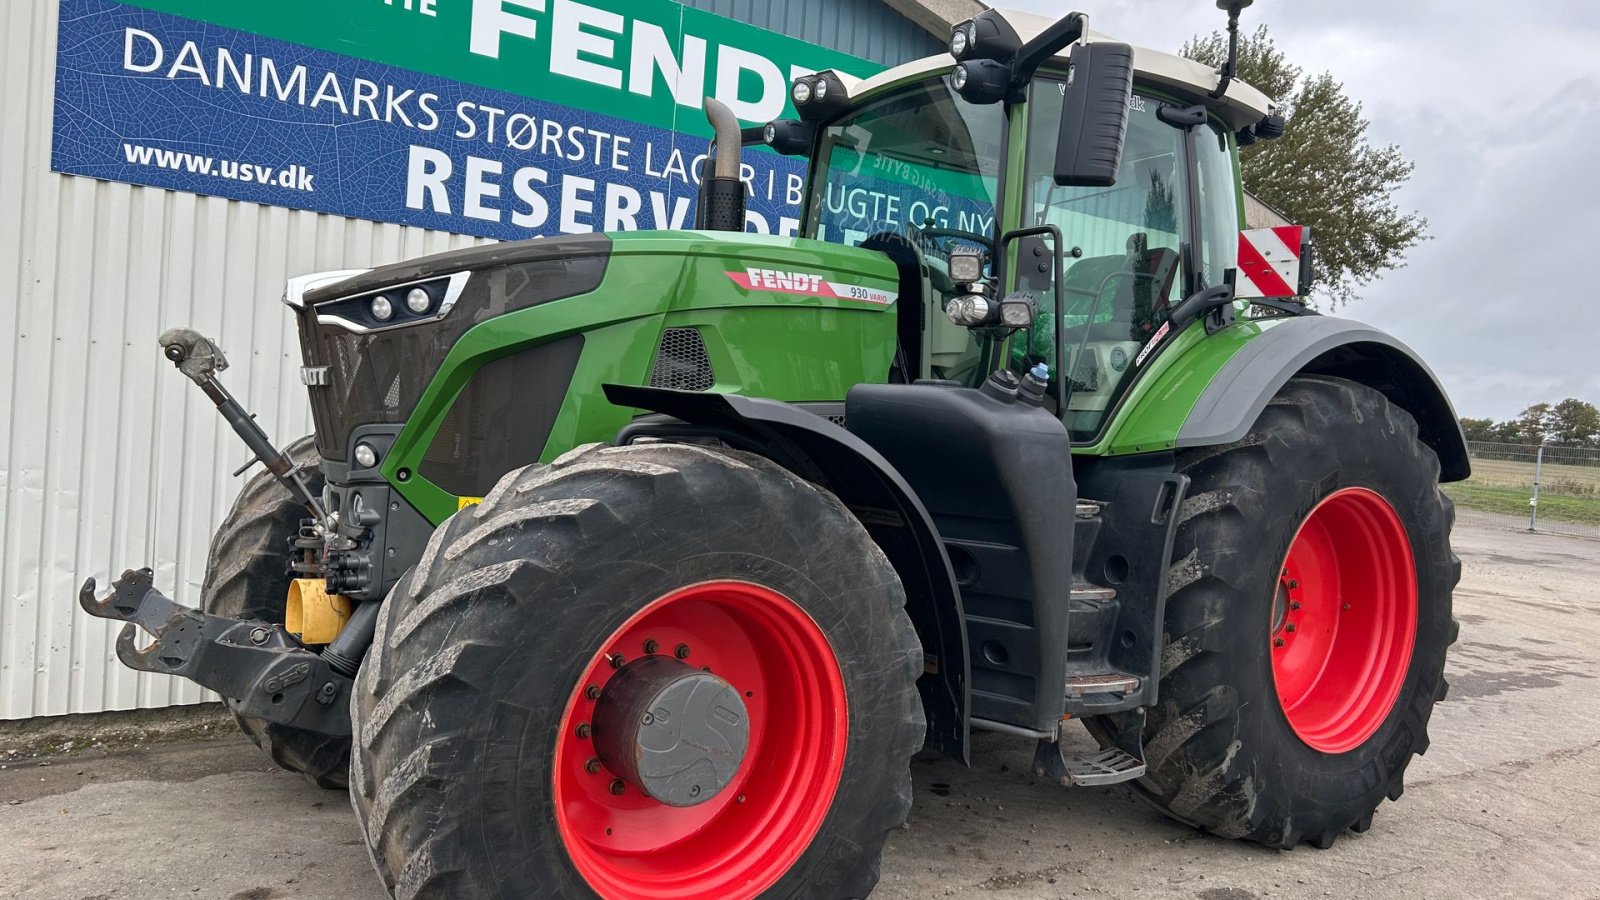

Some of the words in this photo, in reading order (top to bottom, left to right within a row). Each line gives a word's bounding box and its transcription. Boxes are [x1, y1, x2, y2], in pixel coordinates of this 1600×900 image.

[470, 0, 817, 123] FEND
[123, 27, 439, 131] DANMARKS
[455, 101, 631, 171] STØRSTE
[767, 169, 774, 200] I
[909, 201, 949, 230] OG
[123, 143, 314, 192] www.usv.dk
[746, 267, 823, 293] FENDT
[851, 287, 868, 299] 930
[869, 293, 887, 303] VARIO
